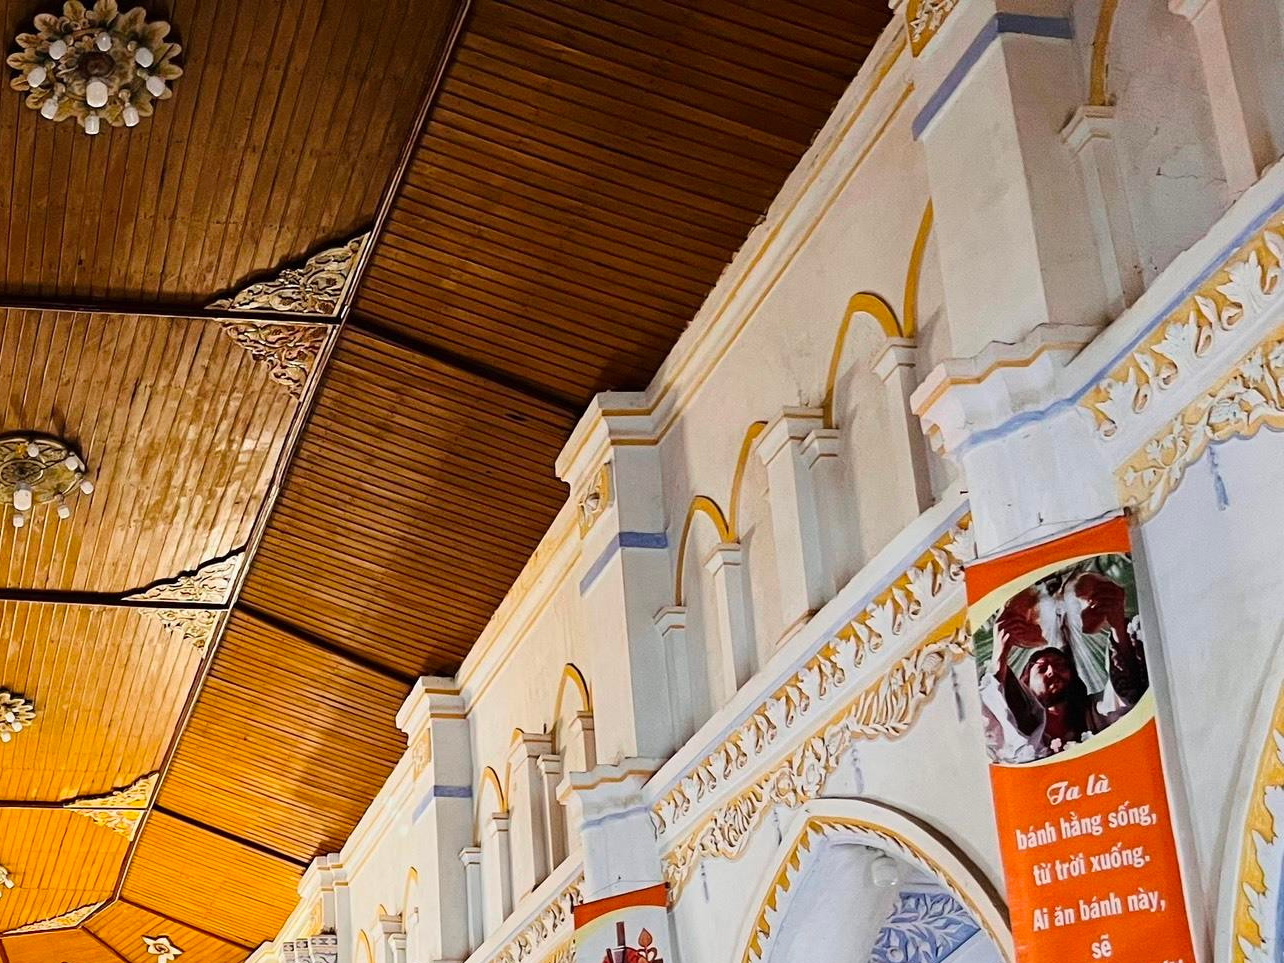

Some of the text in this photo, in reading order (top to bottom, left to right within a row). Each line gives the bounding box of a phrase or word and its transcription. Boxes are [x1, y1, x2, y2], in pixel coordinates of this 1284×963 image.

[1046, 773, 1111, 805] Ta là
[1016, 800, 1157, 850] bánh hằng sống,
[1033, 842, 1151, 887] từ trời xuống.
[1033, 887, 1166, 932] Ai ăn bánh này,
[1091, 934, 1112, 959] sẽ
